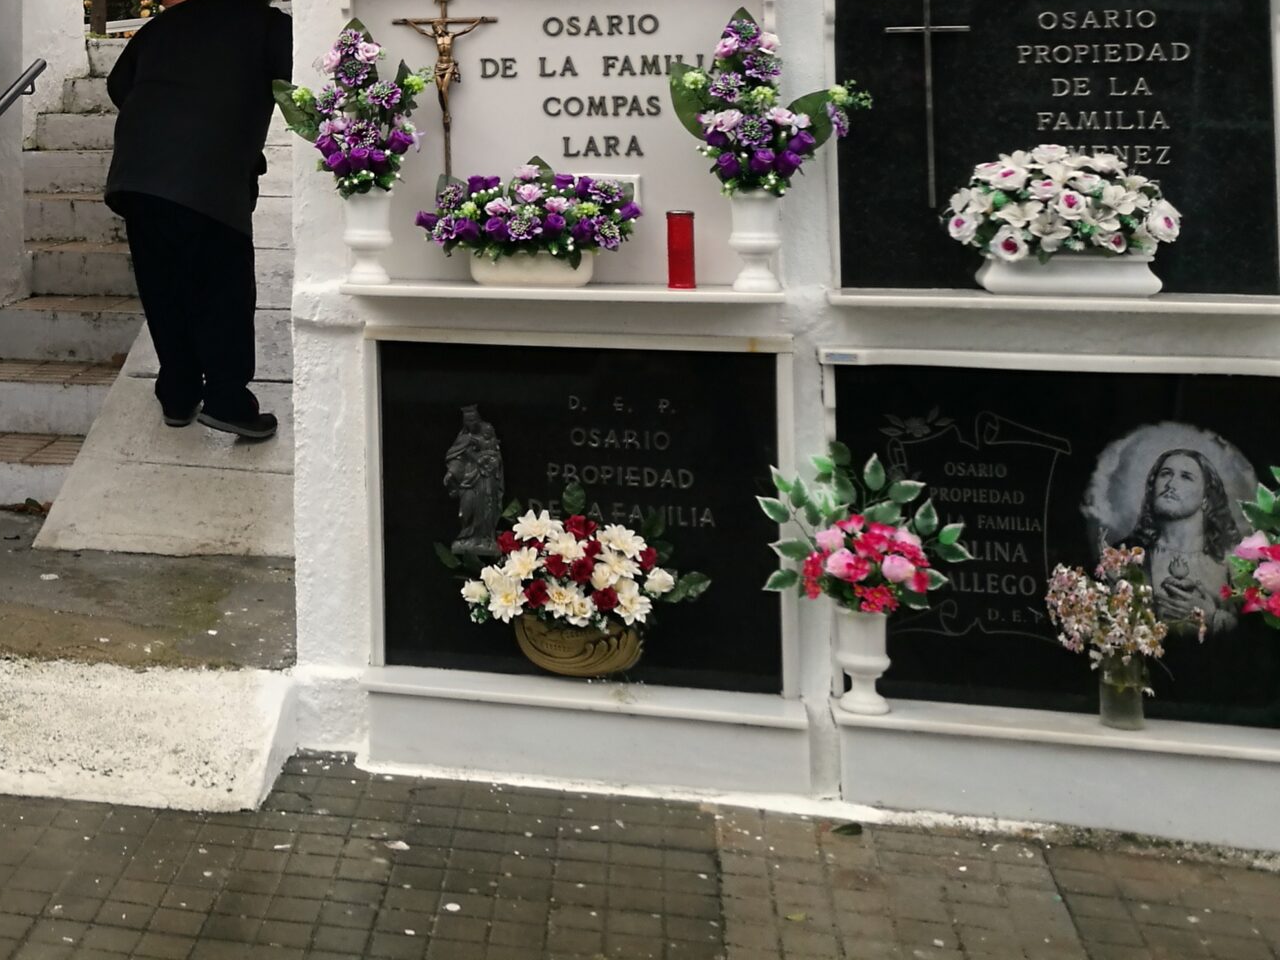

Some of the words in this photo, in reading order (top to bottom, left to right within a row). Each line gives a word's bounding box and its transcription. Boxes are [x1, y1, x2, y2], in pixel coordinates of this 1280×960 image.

[542, 14, 659, 37] OSARIO
[1038, 9, 1157, 30] OSARIO
[1017, 42, 1191, 65] PROPIEDAD
[480, 57, 518, 79] DE
[539, 55, 578, 78] LA
[1051, 77, 1090, 97] DE
[1109, 77, 1153, 96] LA
[543, 95, 661, 118] COMPAS
[1036, 110, 1170, 131] FAMILIA
[563, 135, 644, 158] LARA
[570, 427, 670, 450] OSARIO
[547, 462, 695, 489] PROPIEDAD
[944, 461, 1007, 478] OSARIO
[929, 487, 1025, 505] PROPIEDAD
[977, 514, 1041, 532] FAMILIA
